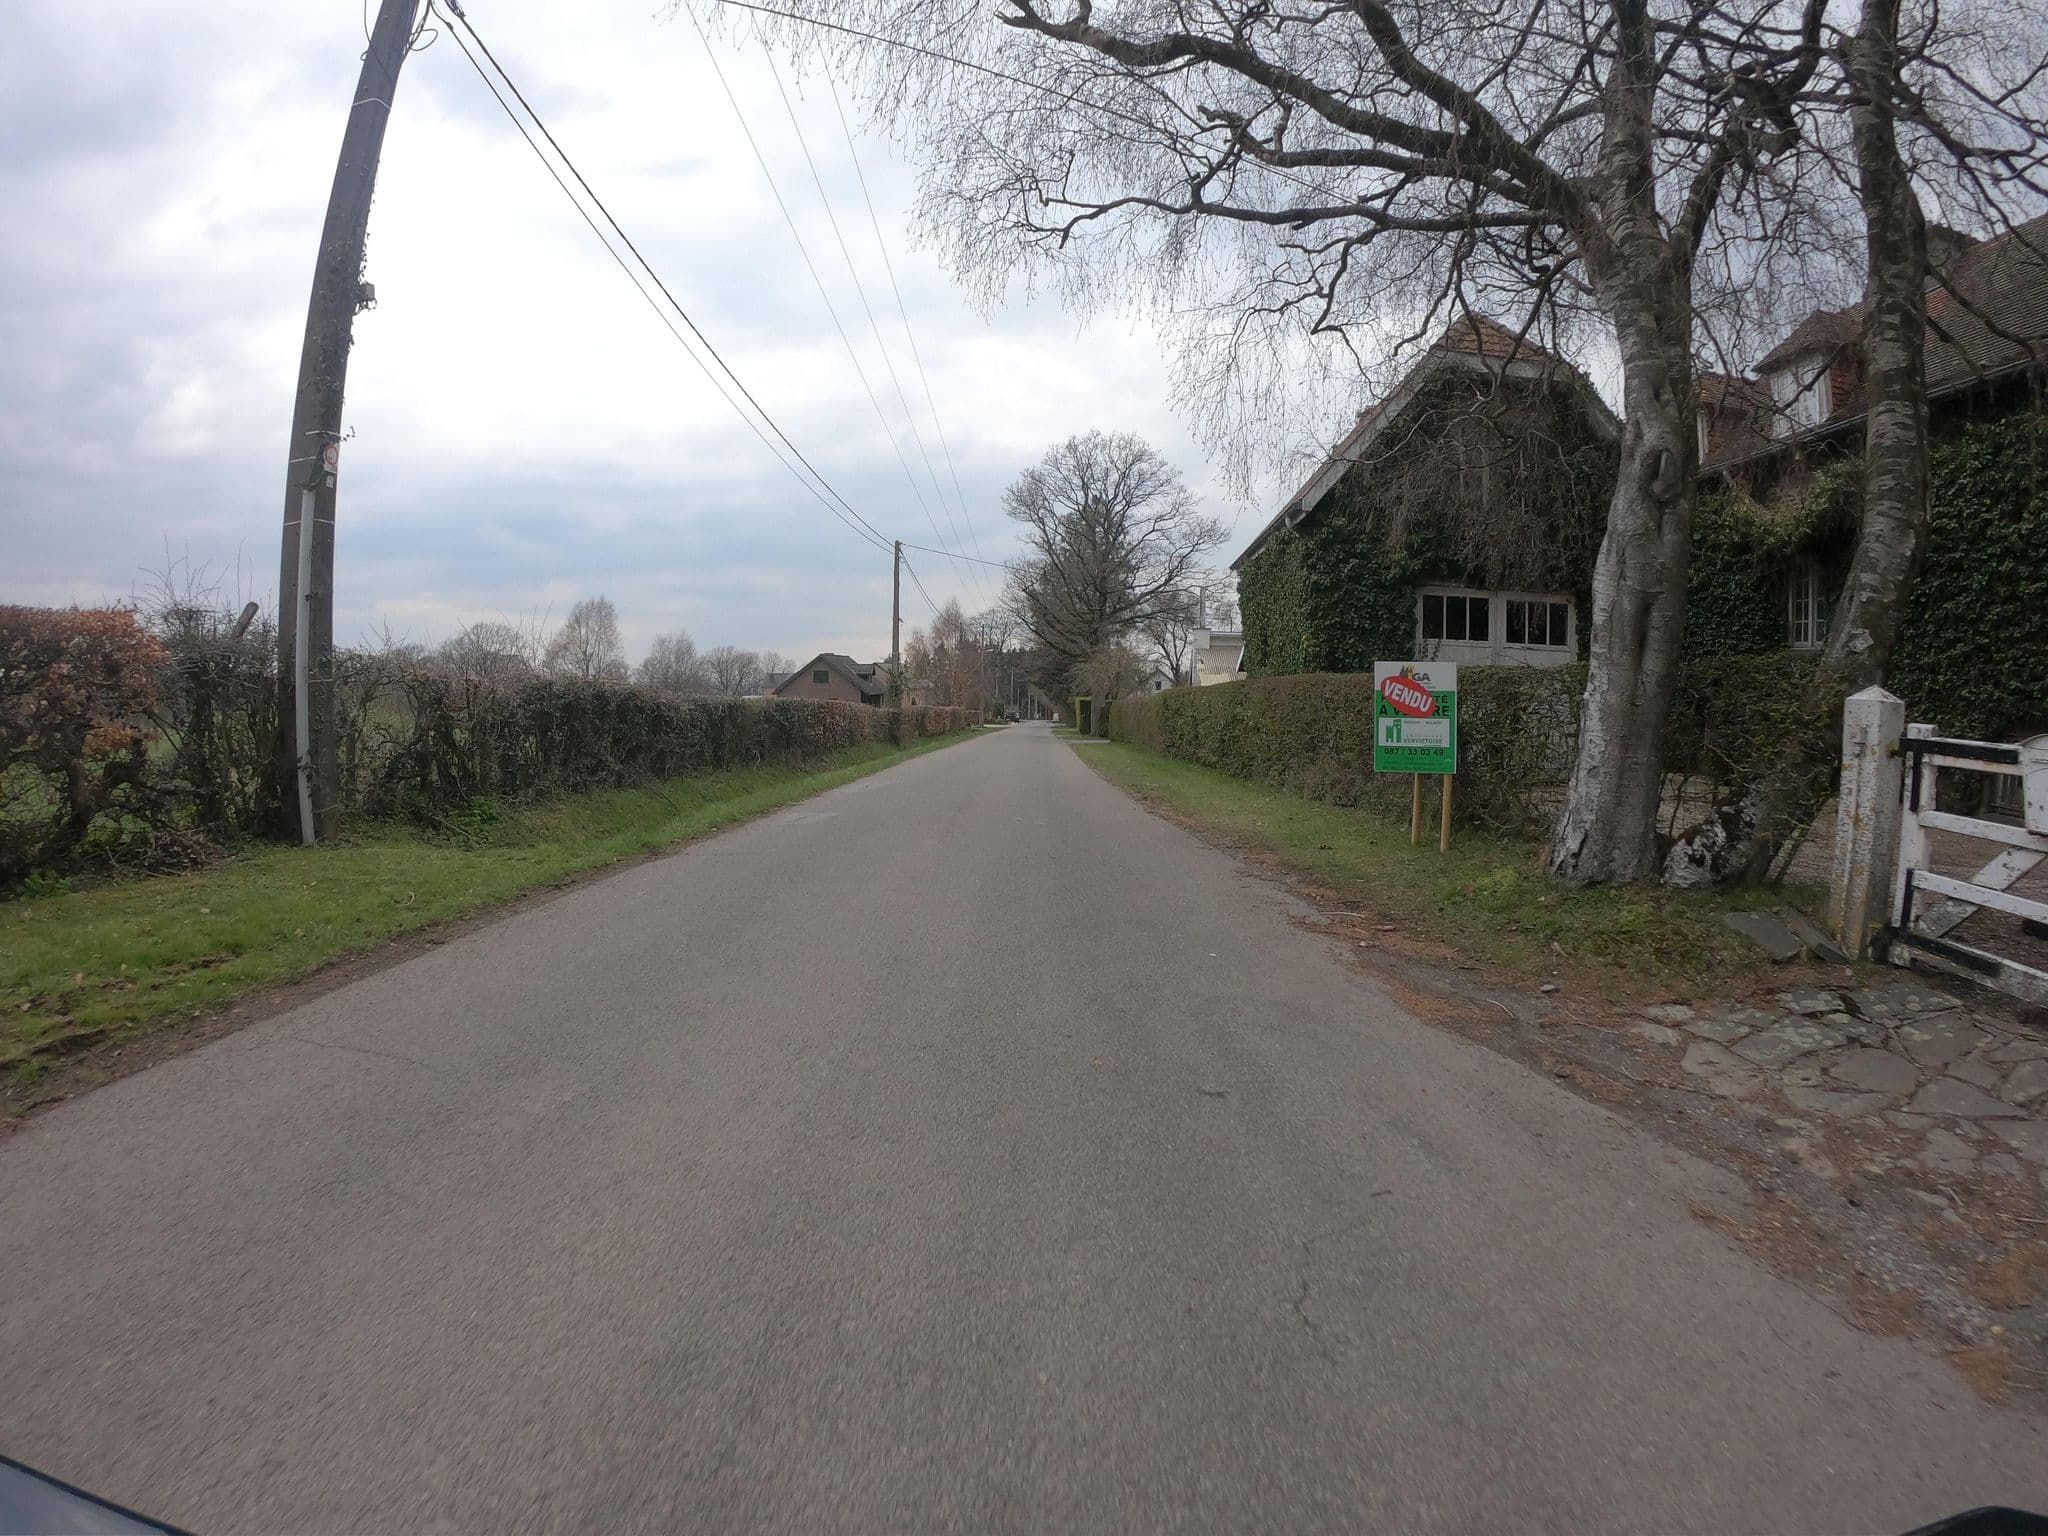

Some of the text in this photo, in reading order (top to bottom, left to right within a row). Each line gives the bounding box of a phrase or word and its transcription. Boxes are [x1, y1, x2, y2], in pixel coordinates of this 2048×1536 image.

[1385, 680, 1433, 712] VENDU
[1379, 705, 1388, 715] A
[1407, 748, 1418, 756] 33
[1420, 748, 1431, 756] 03
